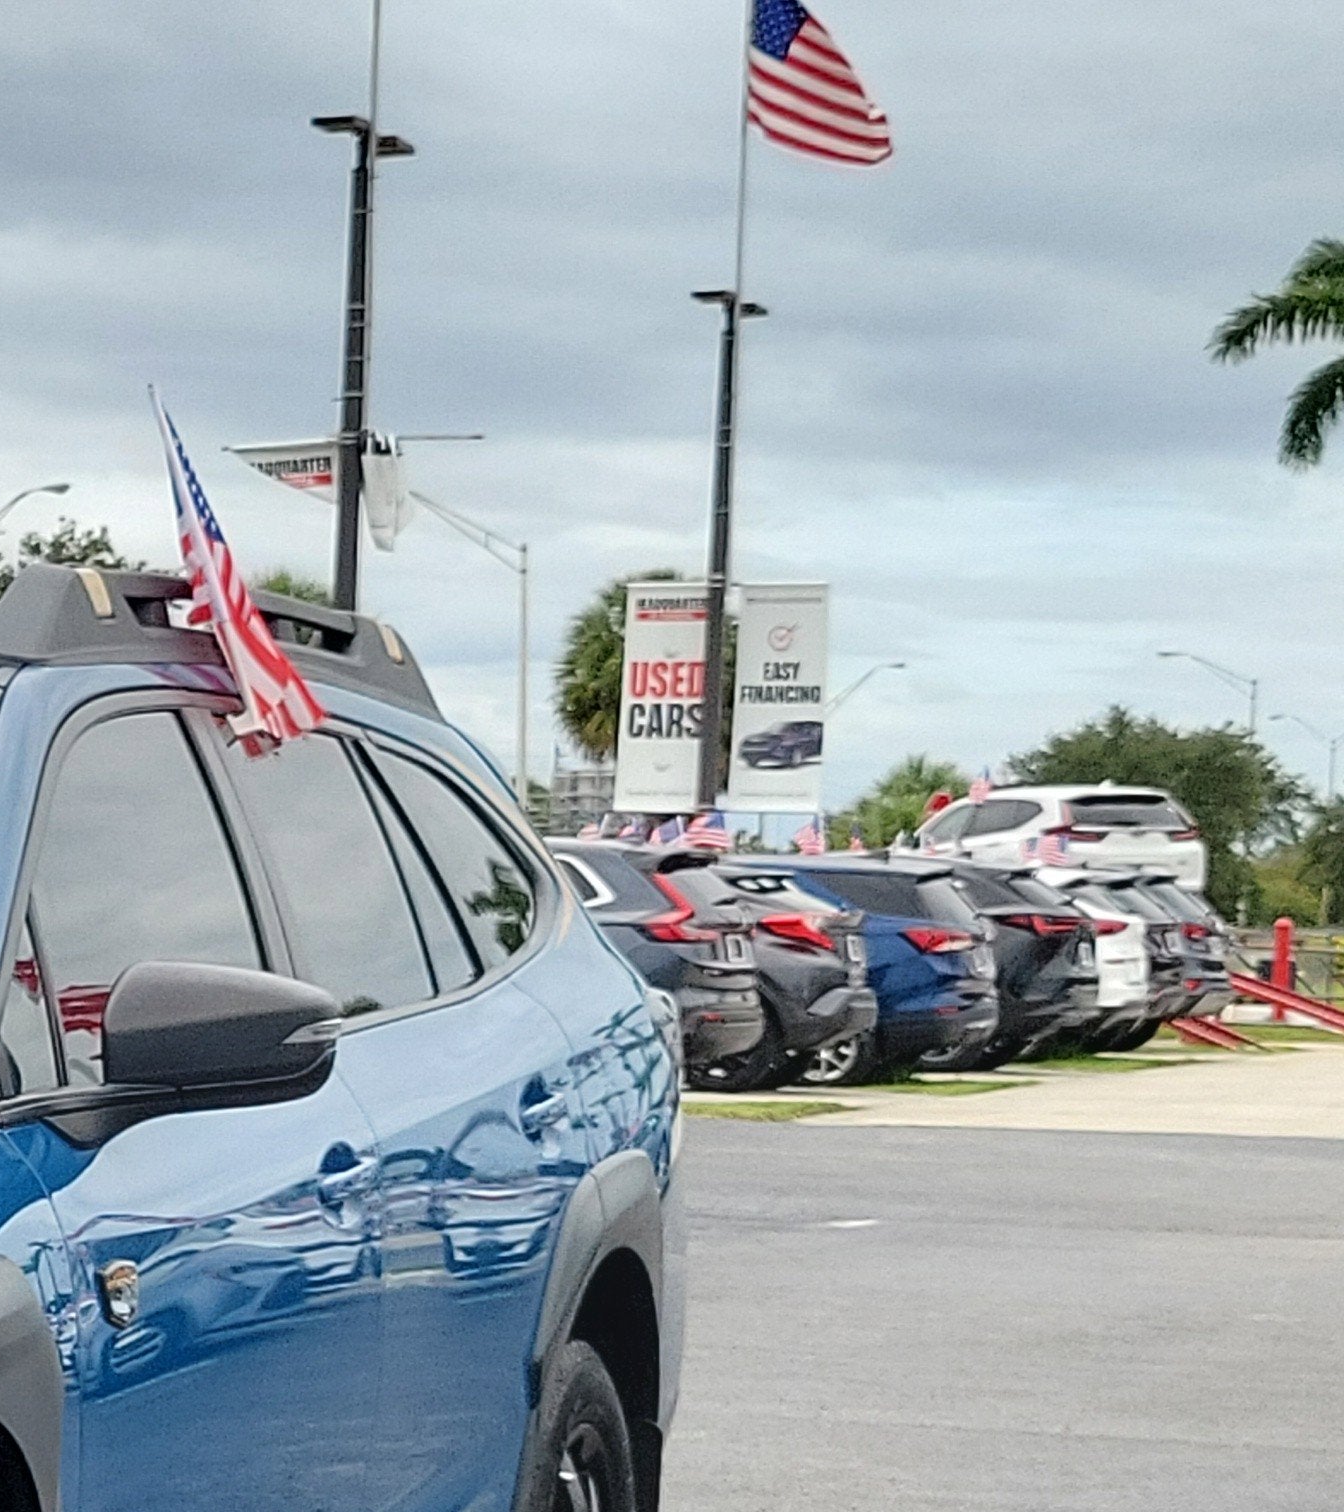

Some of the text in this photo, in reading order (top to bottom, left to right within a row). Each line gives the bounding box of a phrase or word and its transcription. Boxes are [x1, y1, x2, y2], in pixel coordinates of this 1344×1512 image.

[631, 661, 704, 697] USED
[763, 661, 800, 681] EASY
[739, 685, 821, 704] FINANCING
[629, 703, 703, 738] CARS
